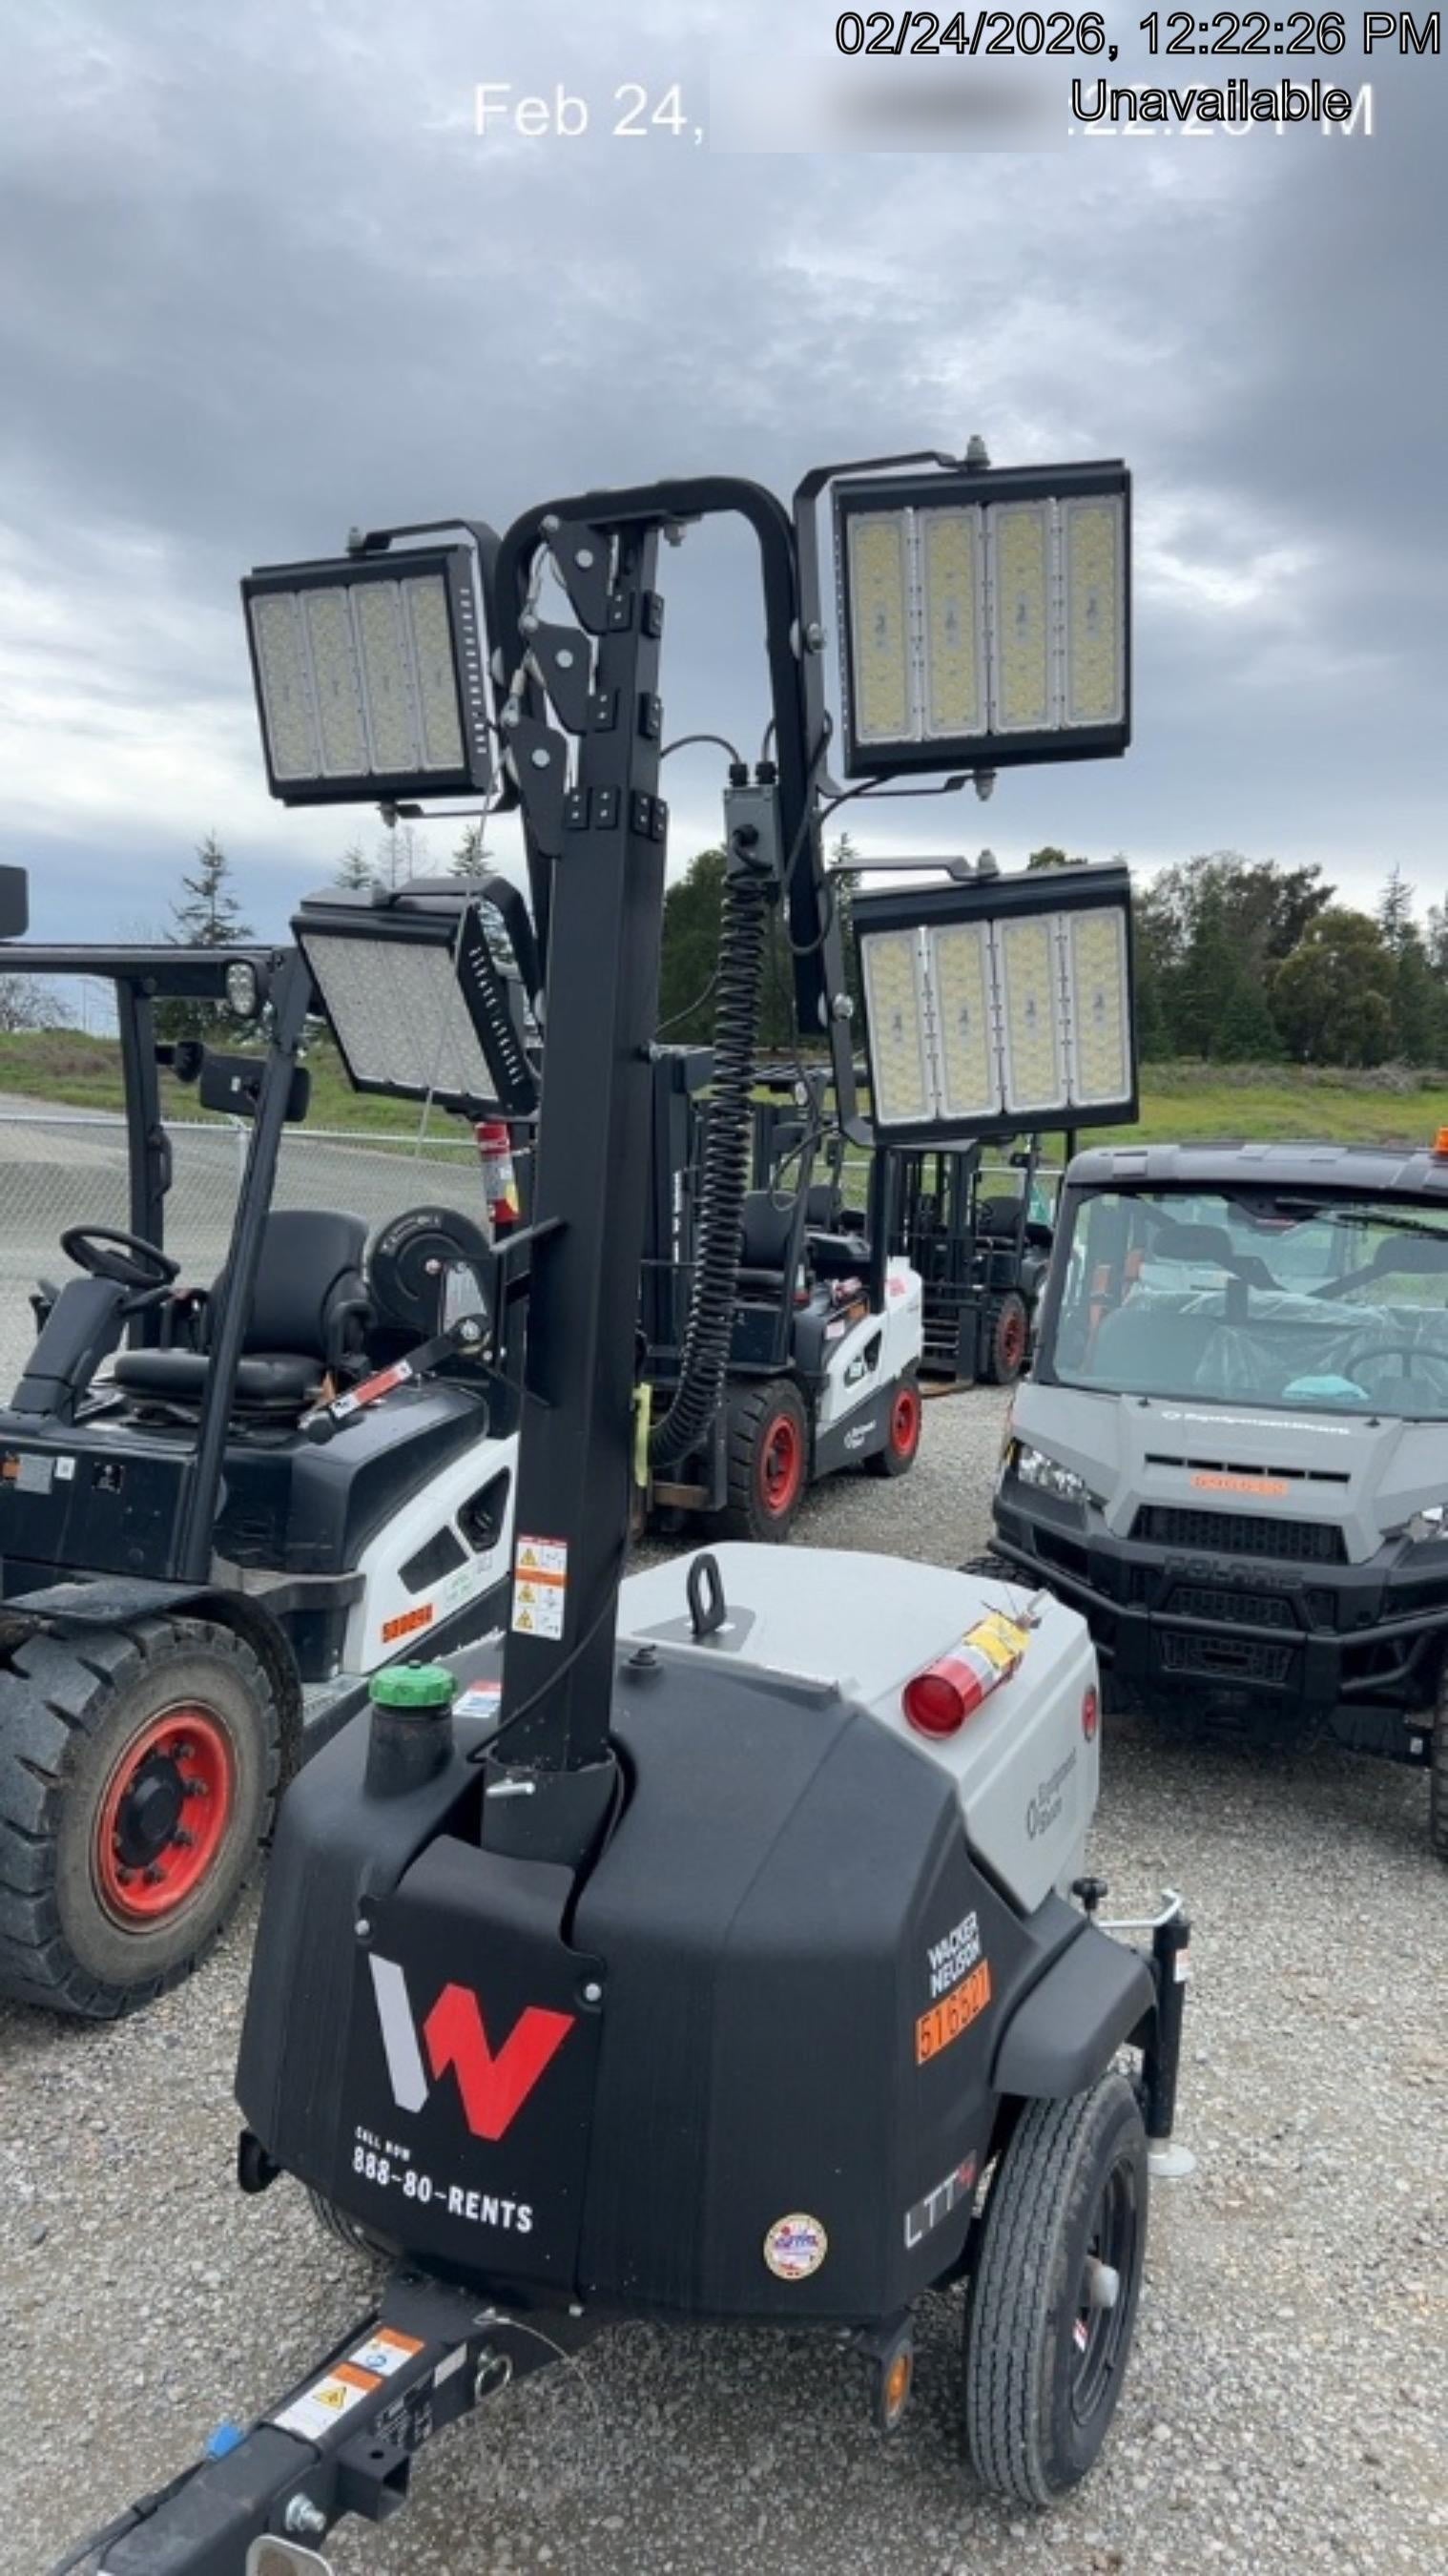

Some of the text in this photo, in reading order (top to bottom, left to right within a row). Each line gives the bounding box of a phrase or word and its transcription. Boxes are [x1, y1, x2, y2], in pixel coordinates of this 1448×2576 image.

[926, 1911, 979, 1970] WACKER
[930, 1939, 982, 1999] NEUSON
[353, 2145, 533, 2233] 888-80-RENTS
